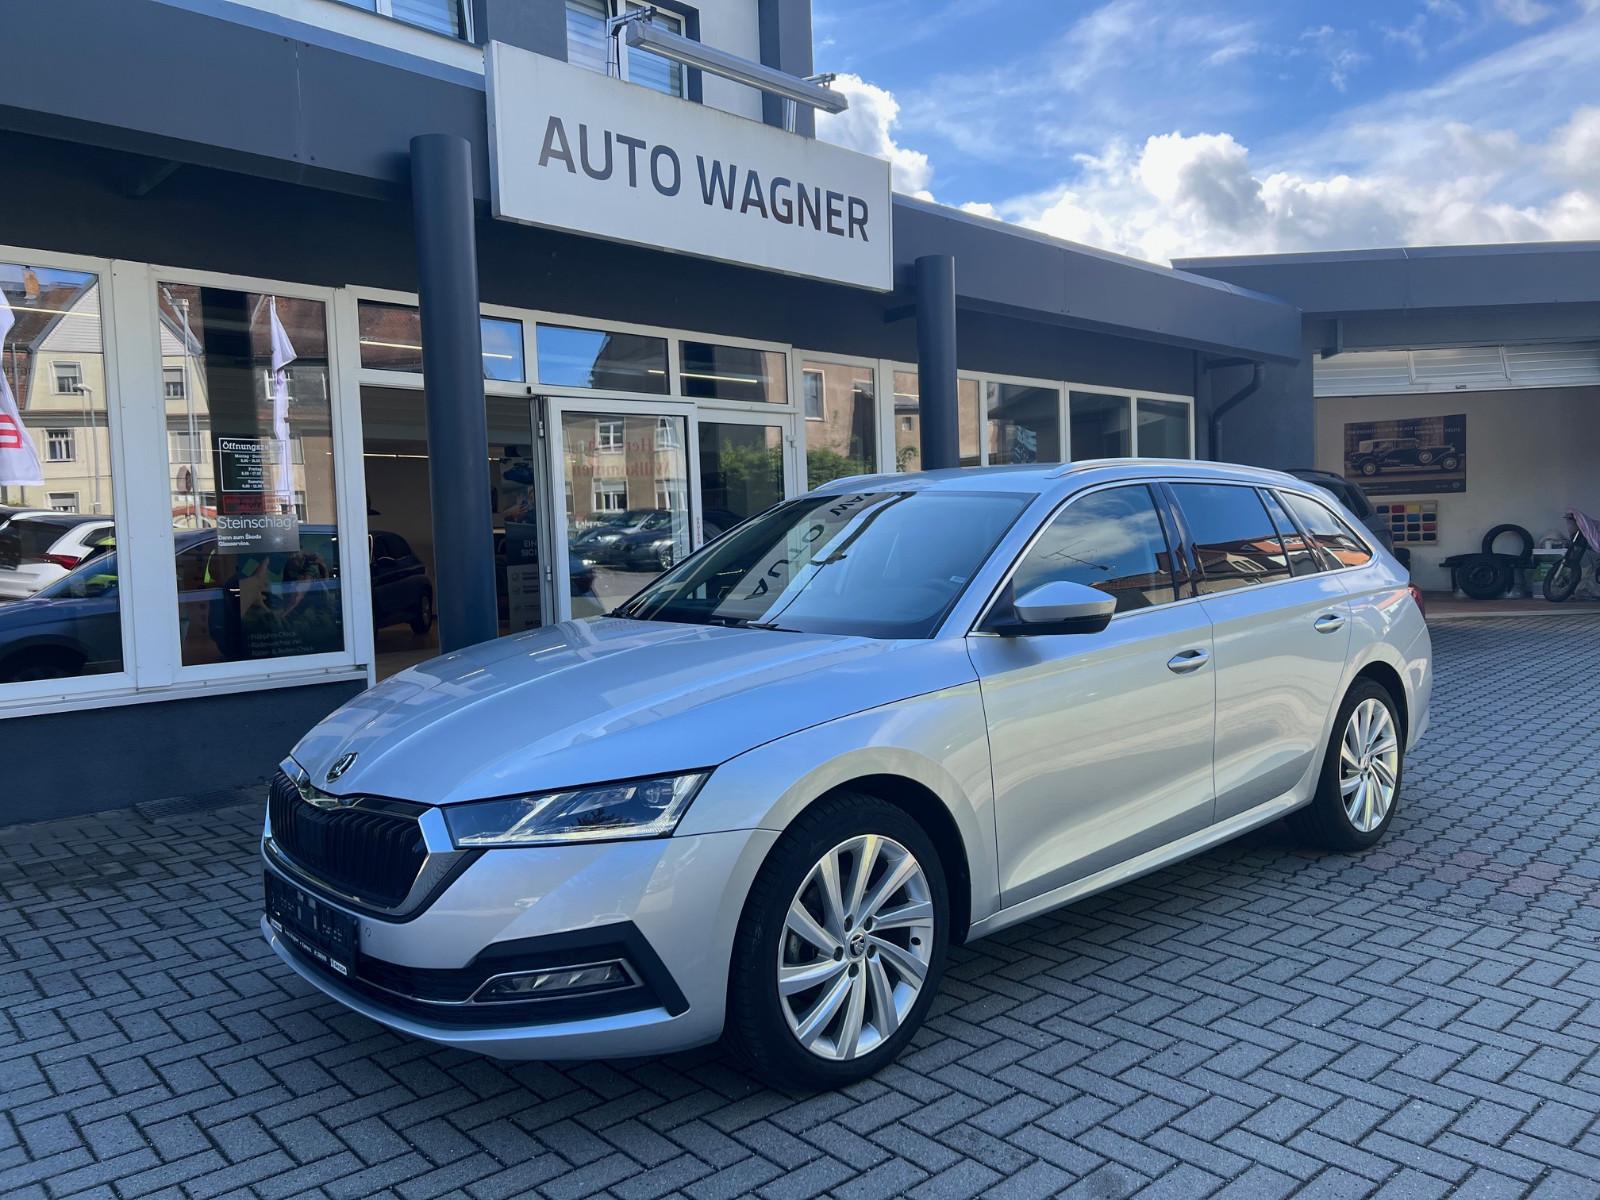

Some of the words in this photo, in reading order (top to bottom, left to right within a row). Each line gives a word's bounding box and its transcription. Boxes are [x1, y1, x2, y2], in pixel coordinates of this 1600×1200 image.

[537, 115, 681, 197] AUTO
[696, 154, 870, 242] WAGNER
[217, 516, 297, 530] Steinschlag?
